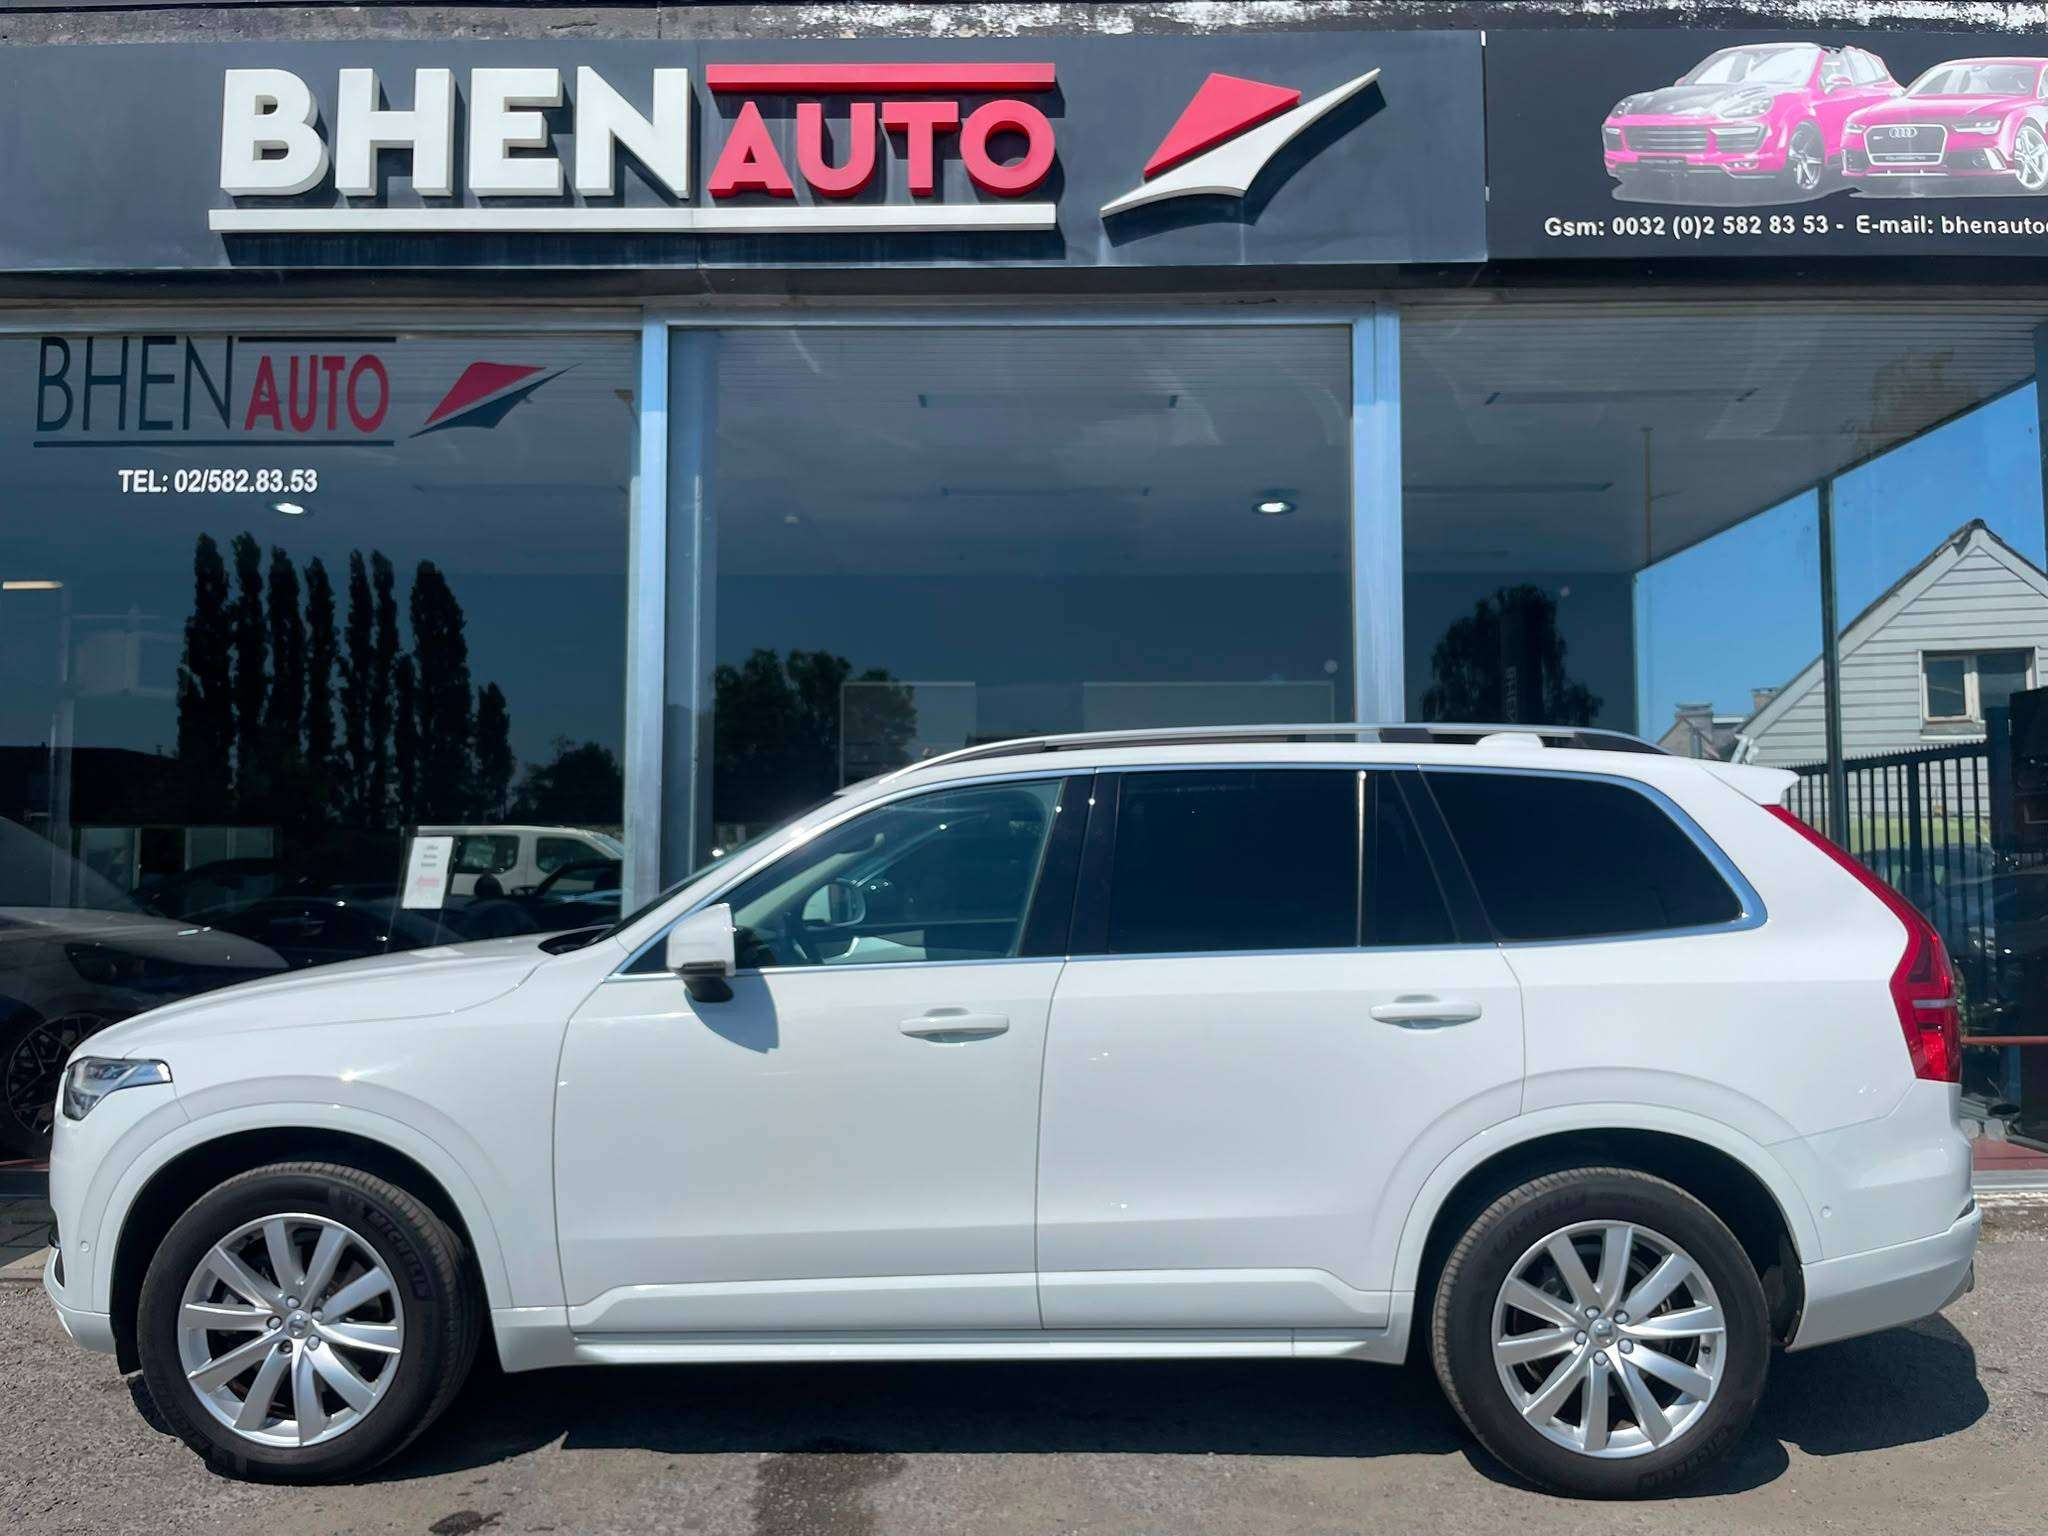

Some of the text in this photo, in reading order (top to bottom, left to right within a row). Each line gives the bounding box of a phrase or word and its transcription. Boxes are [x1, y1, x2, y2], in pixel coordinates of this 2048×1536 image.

[1544, 217, 1605, 236] Gsm:
[1612, 217, 1666, 235] 0032
[1672, 215, 1715, 239] (0)2
[1722, 216, 1762, 234] 582
[1769, 215, 1796, 234] 83
[1803, 215, 1829, 234] 53
[1856, 215, 1934, 234] E-mail:
[1941, 215, 2048, 234] bhenauto
[118, 468, 318, 493] TEL: 02/582.83.53
